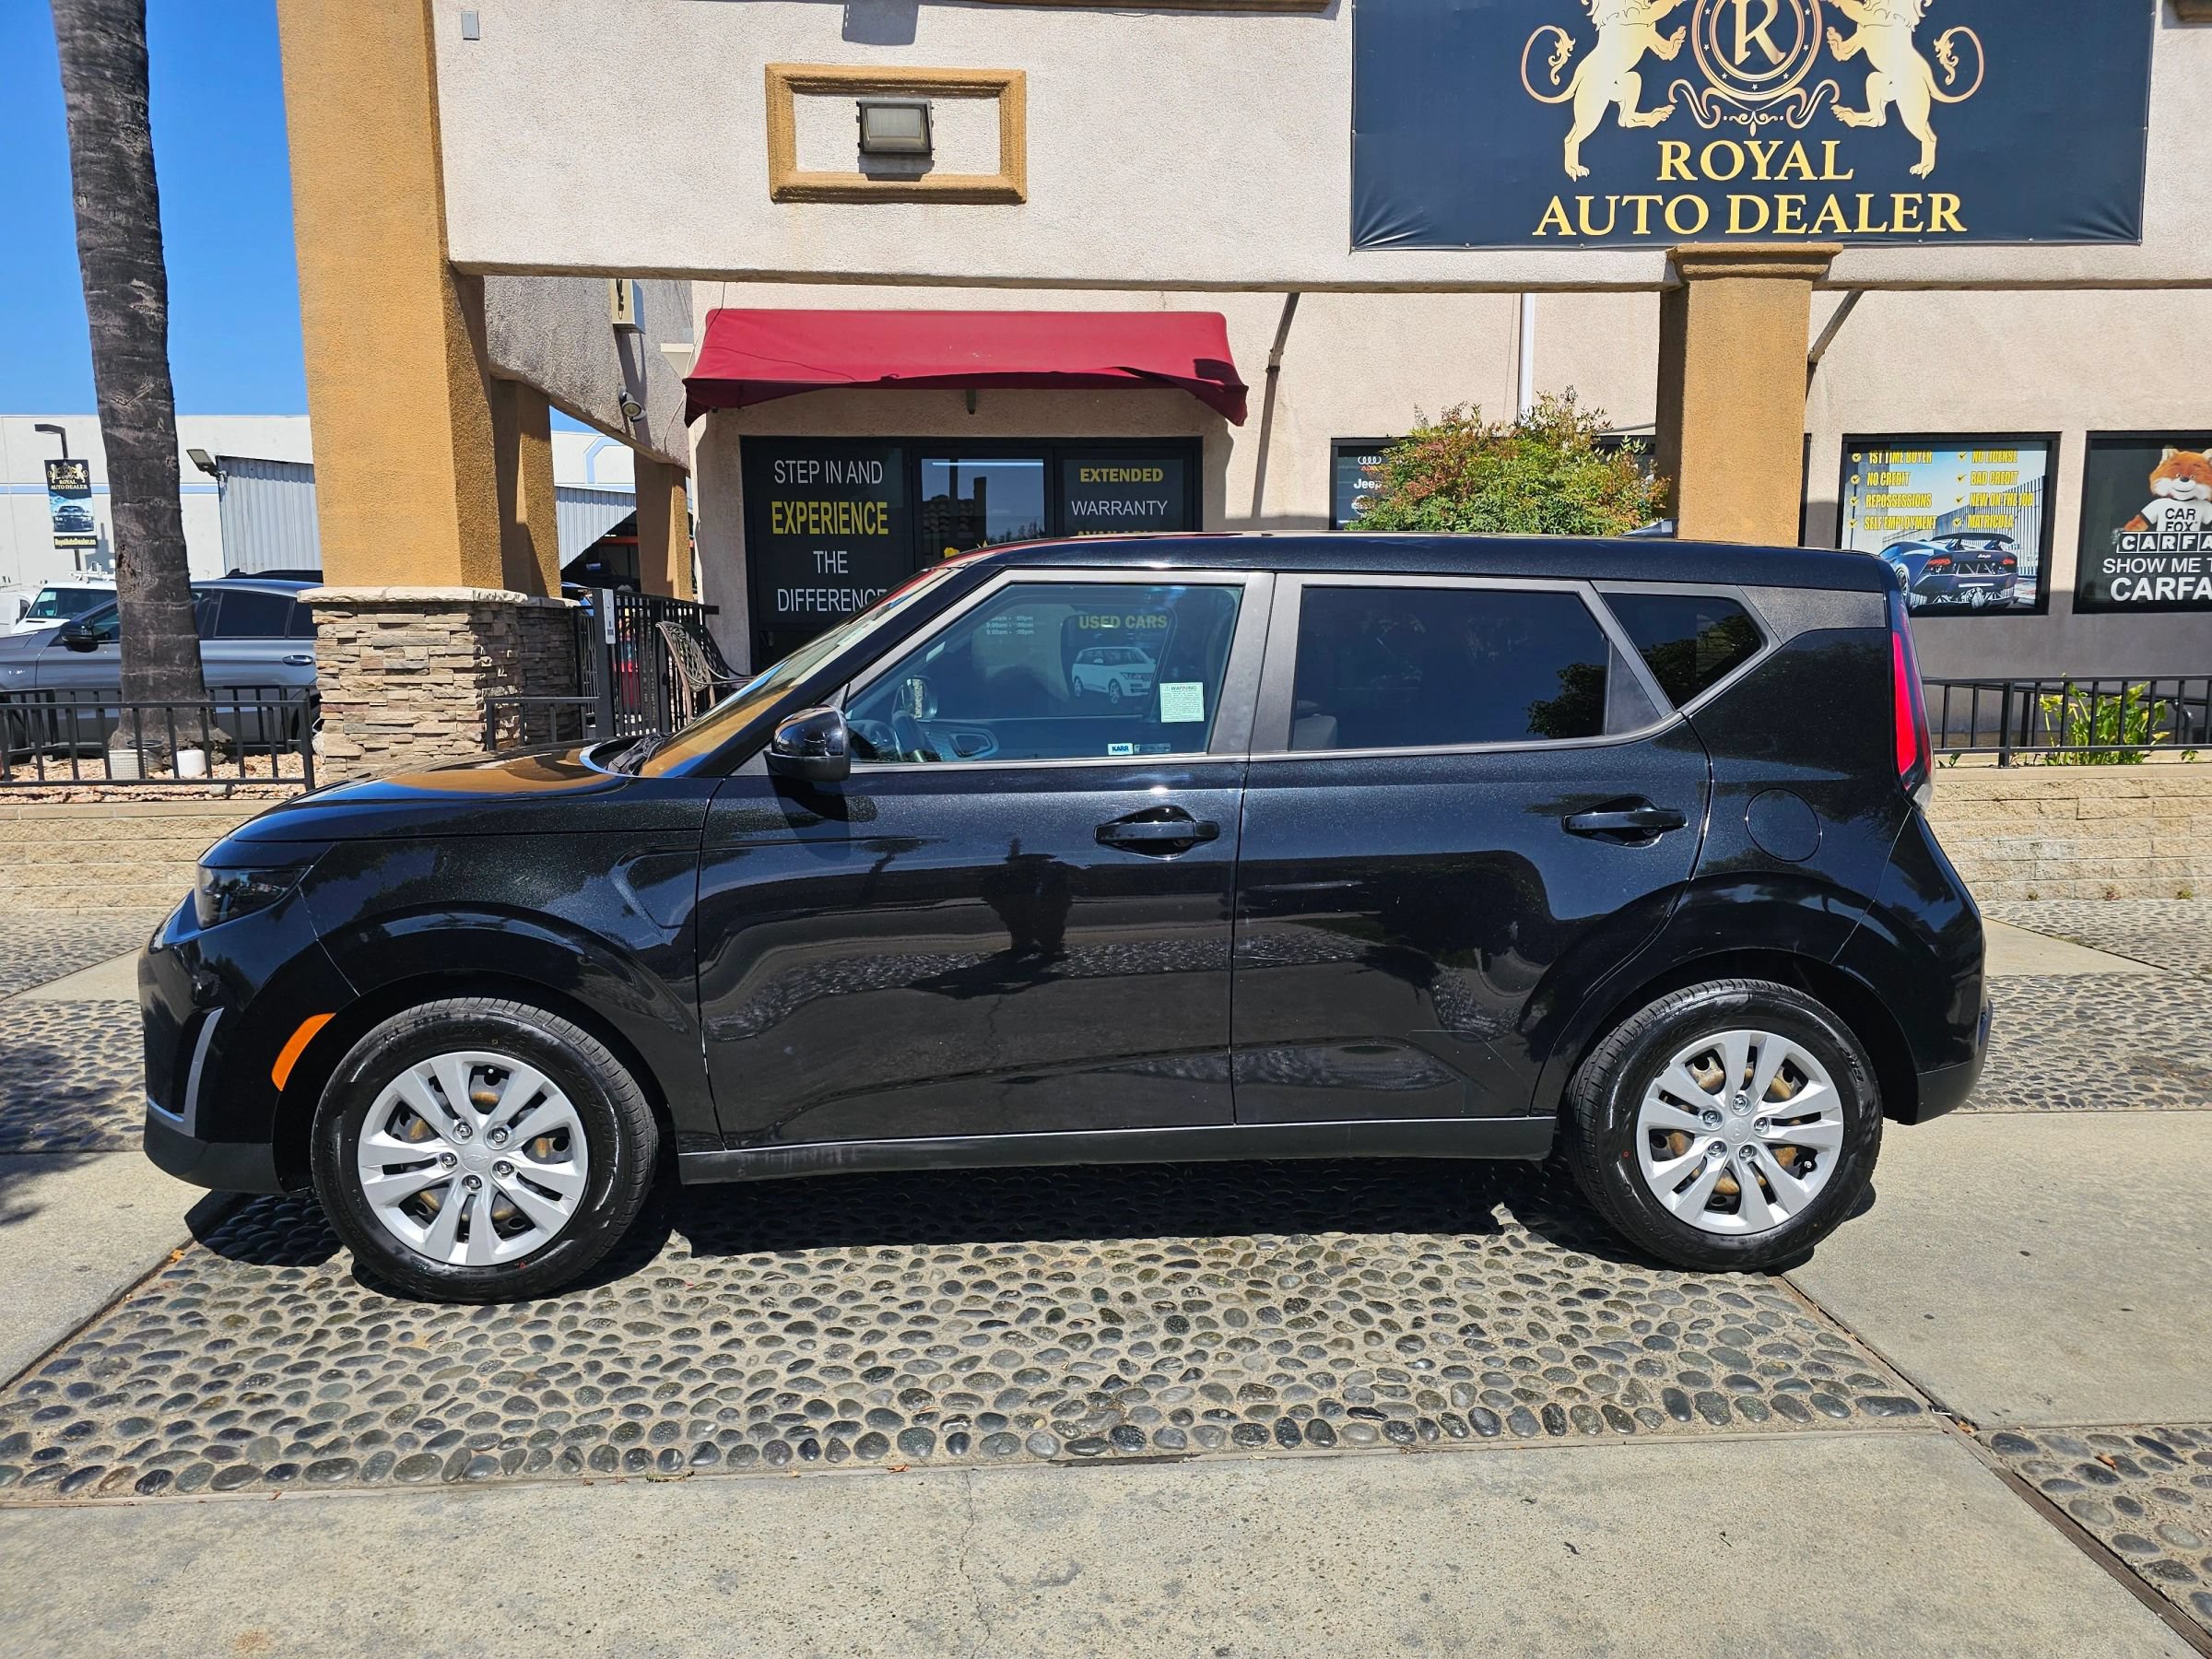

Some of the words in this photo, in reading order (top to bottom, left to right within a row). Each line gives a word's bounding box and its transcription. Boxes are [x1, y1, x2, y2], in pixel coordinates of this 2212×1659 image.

[1656, 139, 1854, 182] ROYAL
[1531, 193, 1711, 236] AUTO
[1724, 192, 1969, 235] DEALER
[1884, 451, 1904, 465] TIME
[1905, 451, 1933, 464] BUYER
[1972, 449, 1983, 464] NO
[1985, 449, 2018, 464] LICENSE
[774, 460, 819, 484] STEP
[825, 460, 842, 484] IN
[846, 460, 883, 484] AND
[1079, 467, 1164, 483] EXTENDED
[1866, 471, 1879, 487] NO
[1880, 471, 1911, 487] CREDIT
[1971, 470, 1988, 486] BAD
[1989, 470, 2018, 486] CREDIT
[1865, 493, 1933, 509] REPOSSESSIONS
[1970, 492, 1989, 507] NEW
[1990, 492, 2001, 507] ON
[2003, 492, 2018, 507] THE
[2019, 492, 2035, 507] JOB
[1071, 500, 1169, 516] WARRANTY
[2165, 508, 2196, 520] CAR
[771, 500, 889, 535] EXPERIENCE
[1864, 516, 1882, 531] SELF
[1883, 516, 1937, 531] EMPLOYMENT
[1967, 514, 2013, 529] MATRICULA
[2166, 521, 2194, 532] FOX
[813, 550, 849, 573] THE
[2102, 558, 2167, 574] SHOW
[2171, 558, 2202, 573] ME
[777, 588, 888, 612] DIFFERENC
[1078, 615, 1122, 629] USED
[1124, 615, 1168, 629] CARS
